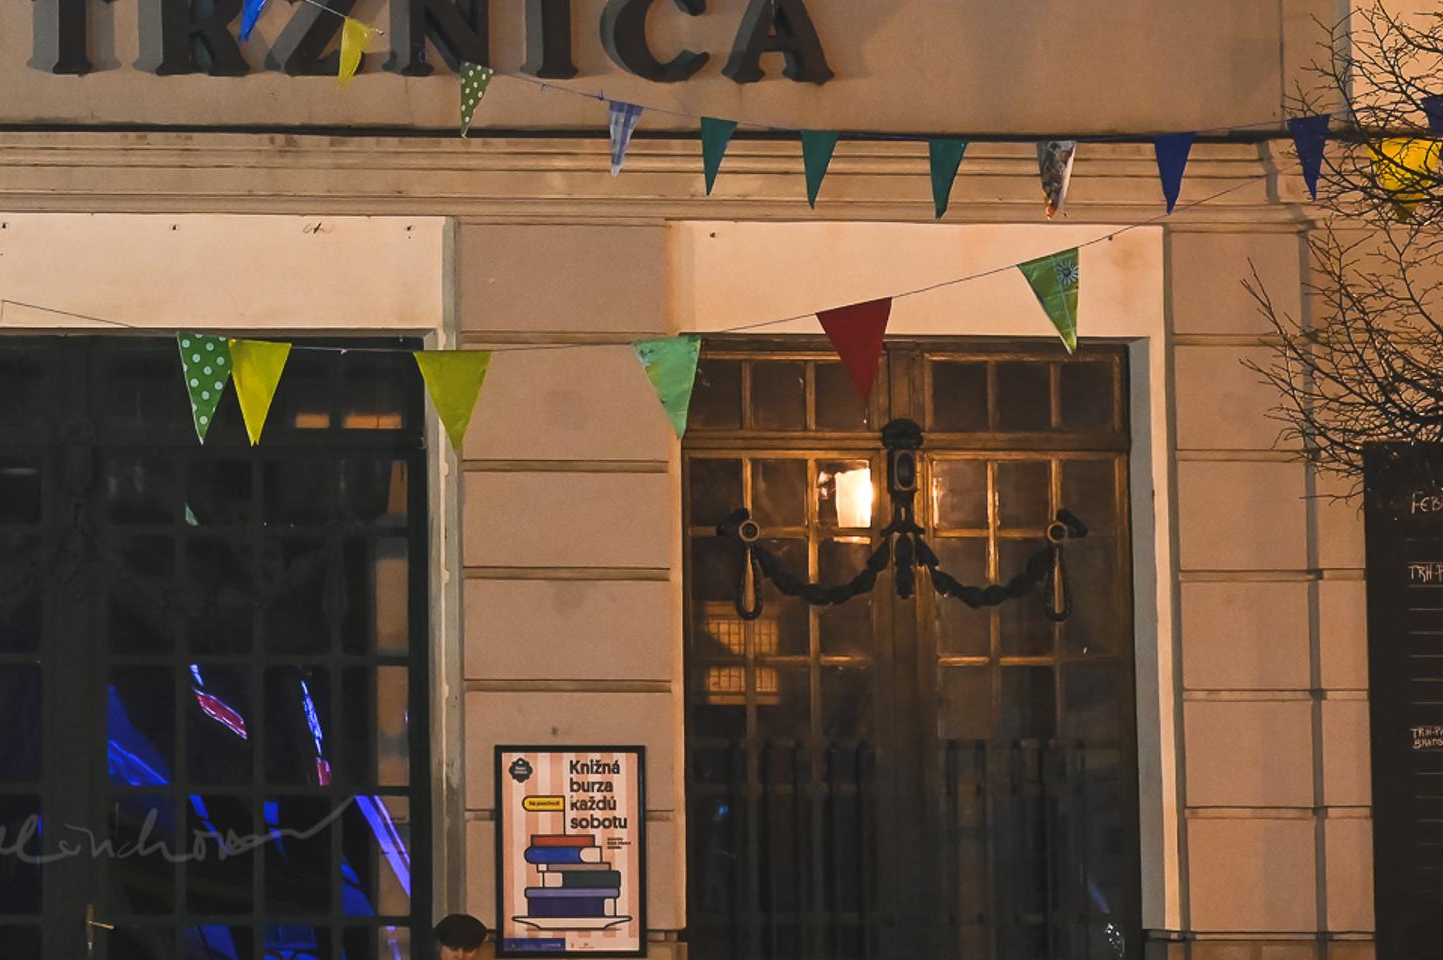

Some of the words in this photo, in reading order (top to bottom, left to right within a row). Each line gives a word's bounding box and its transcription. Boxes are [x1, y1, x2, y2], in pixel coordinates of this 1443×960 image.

[569, 759, 620, 775] Knižná
[569, 778, 614, 793] burza
[569, 795, 616, 811] každú
[570, 815, 627, 829] sobotu
